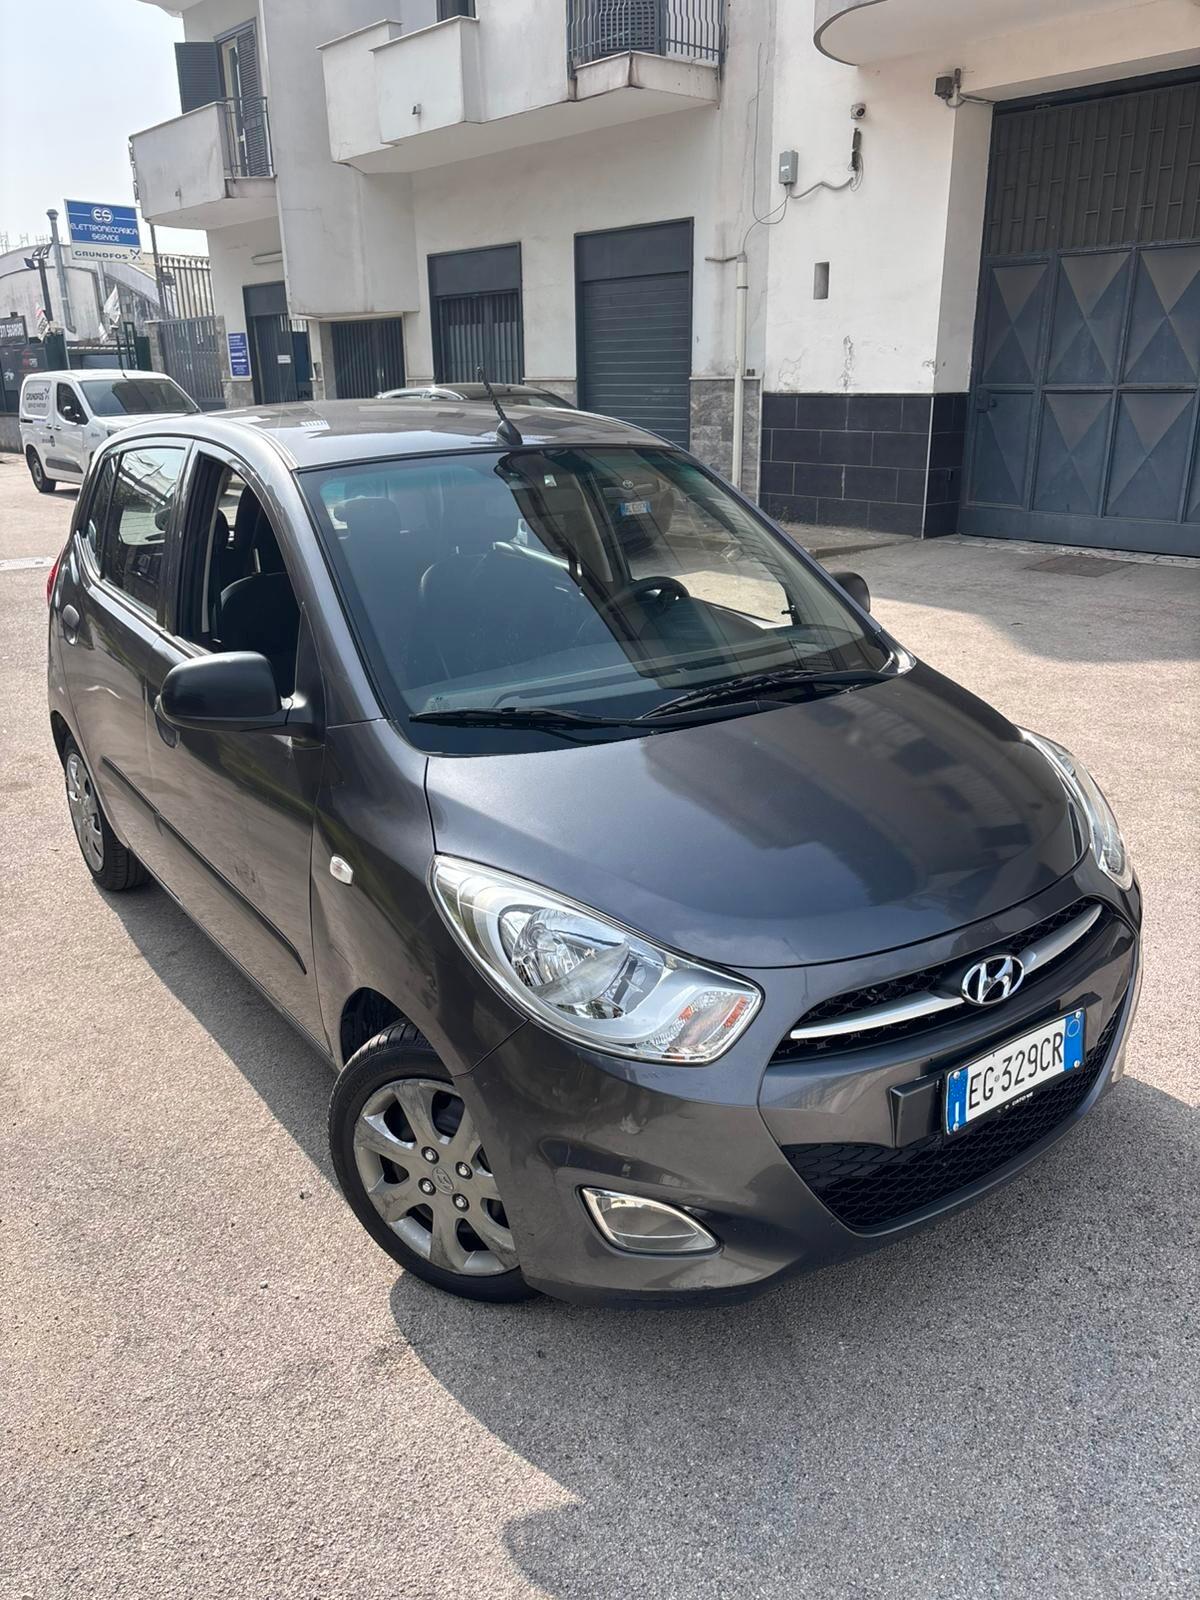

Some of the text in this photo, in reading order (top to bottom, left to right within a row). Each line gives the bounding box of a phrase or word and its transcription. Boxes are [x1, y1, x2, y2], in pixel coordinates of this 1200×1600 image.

[70, 222, 138, 235] ELETTROMECCANICA
[91, 232, 120, 242] SERVICE
[74, 250, 129, 260] GRUNDFOS
